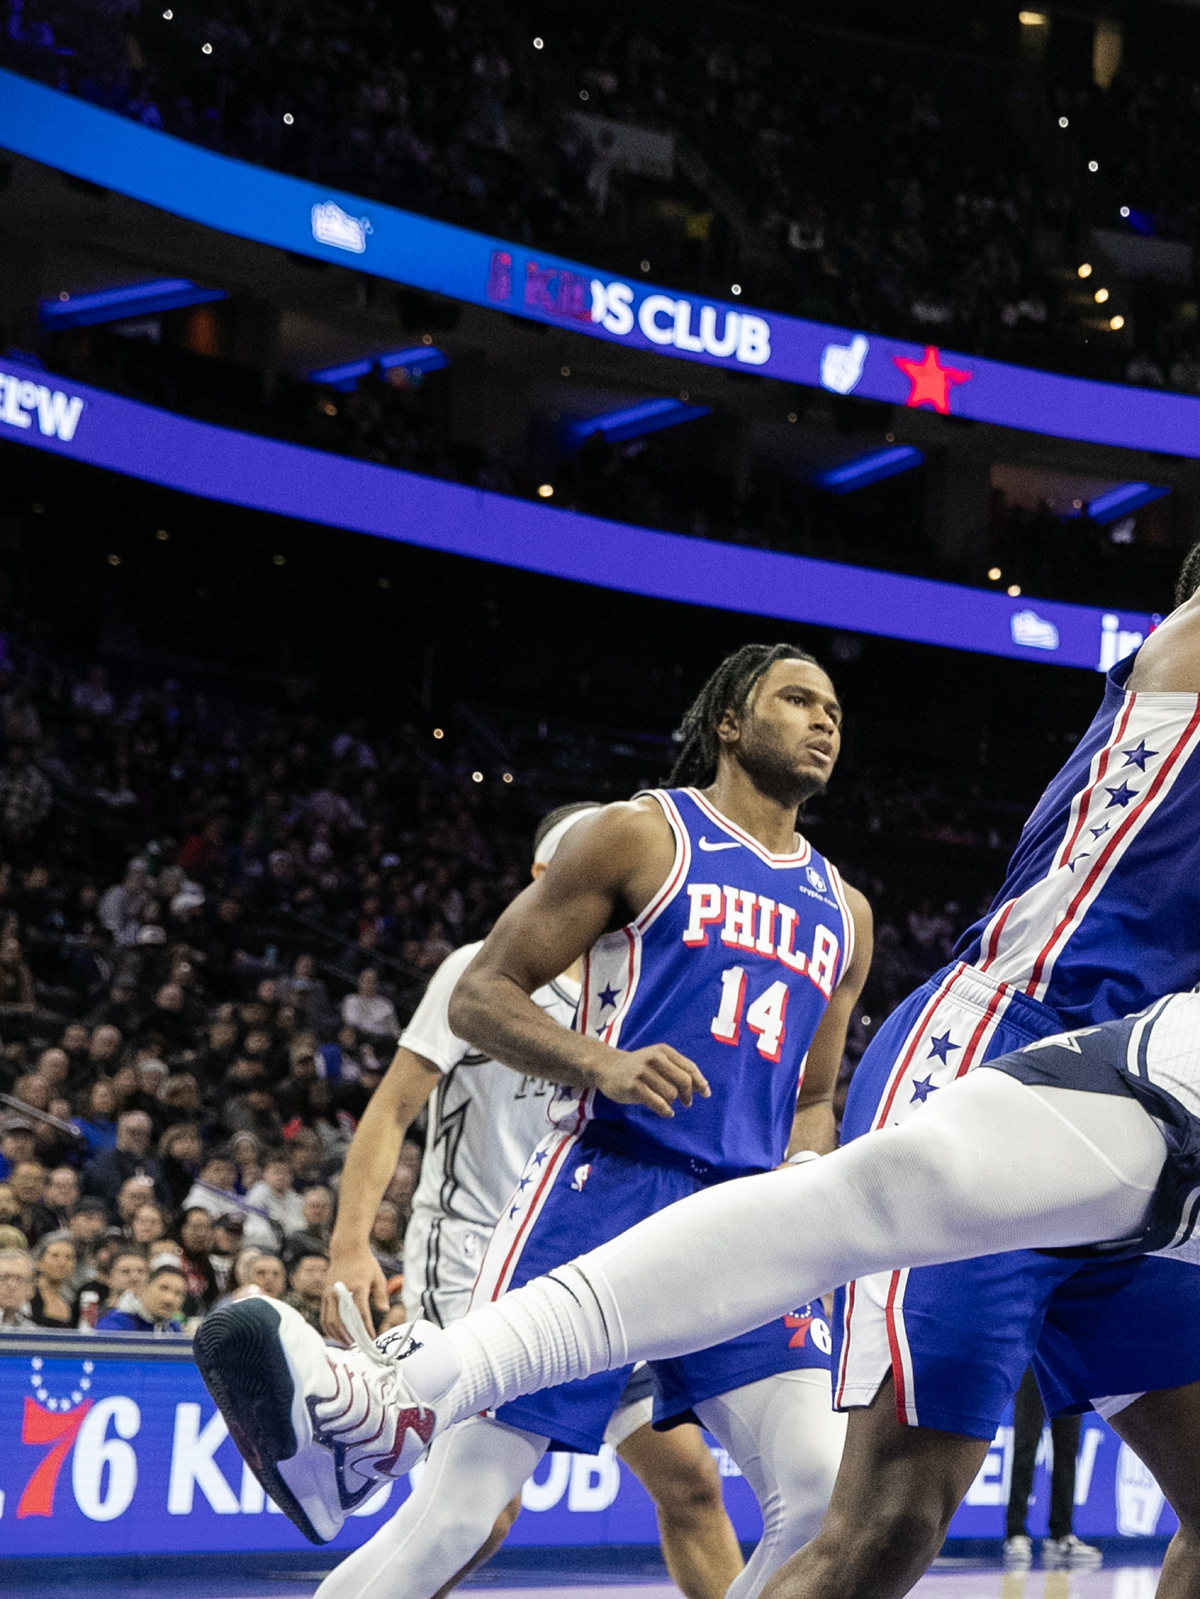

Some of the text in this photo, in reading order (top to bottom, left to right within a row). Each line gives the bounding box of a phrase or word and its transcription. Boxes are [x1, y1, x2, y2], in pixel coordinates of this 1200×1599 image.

[638, 294, 772, 366] CLUB
[682, 883, 840, 1002] PHILA
[710, 965, 789, 1063] 14
[783, 1314, 832, 1356] 76
[16, 1395, 141, 1522] 76
